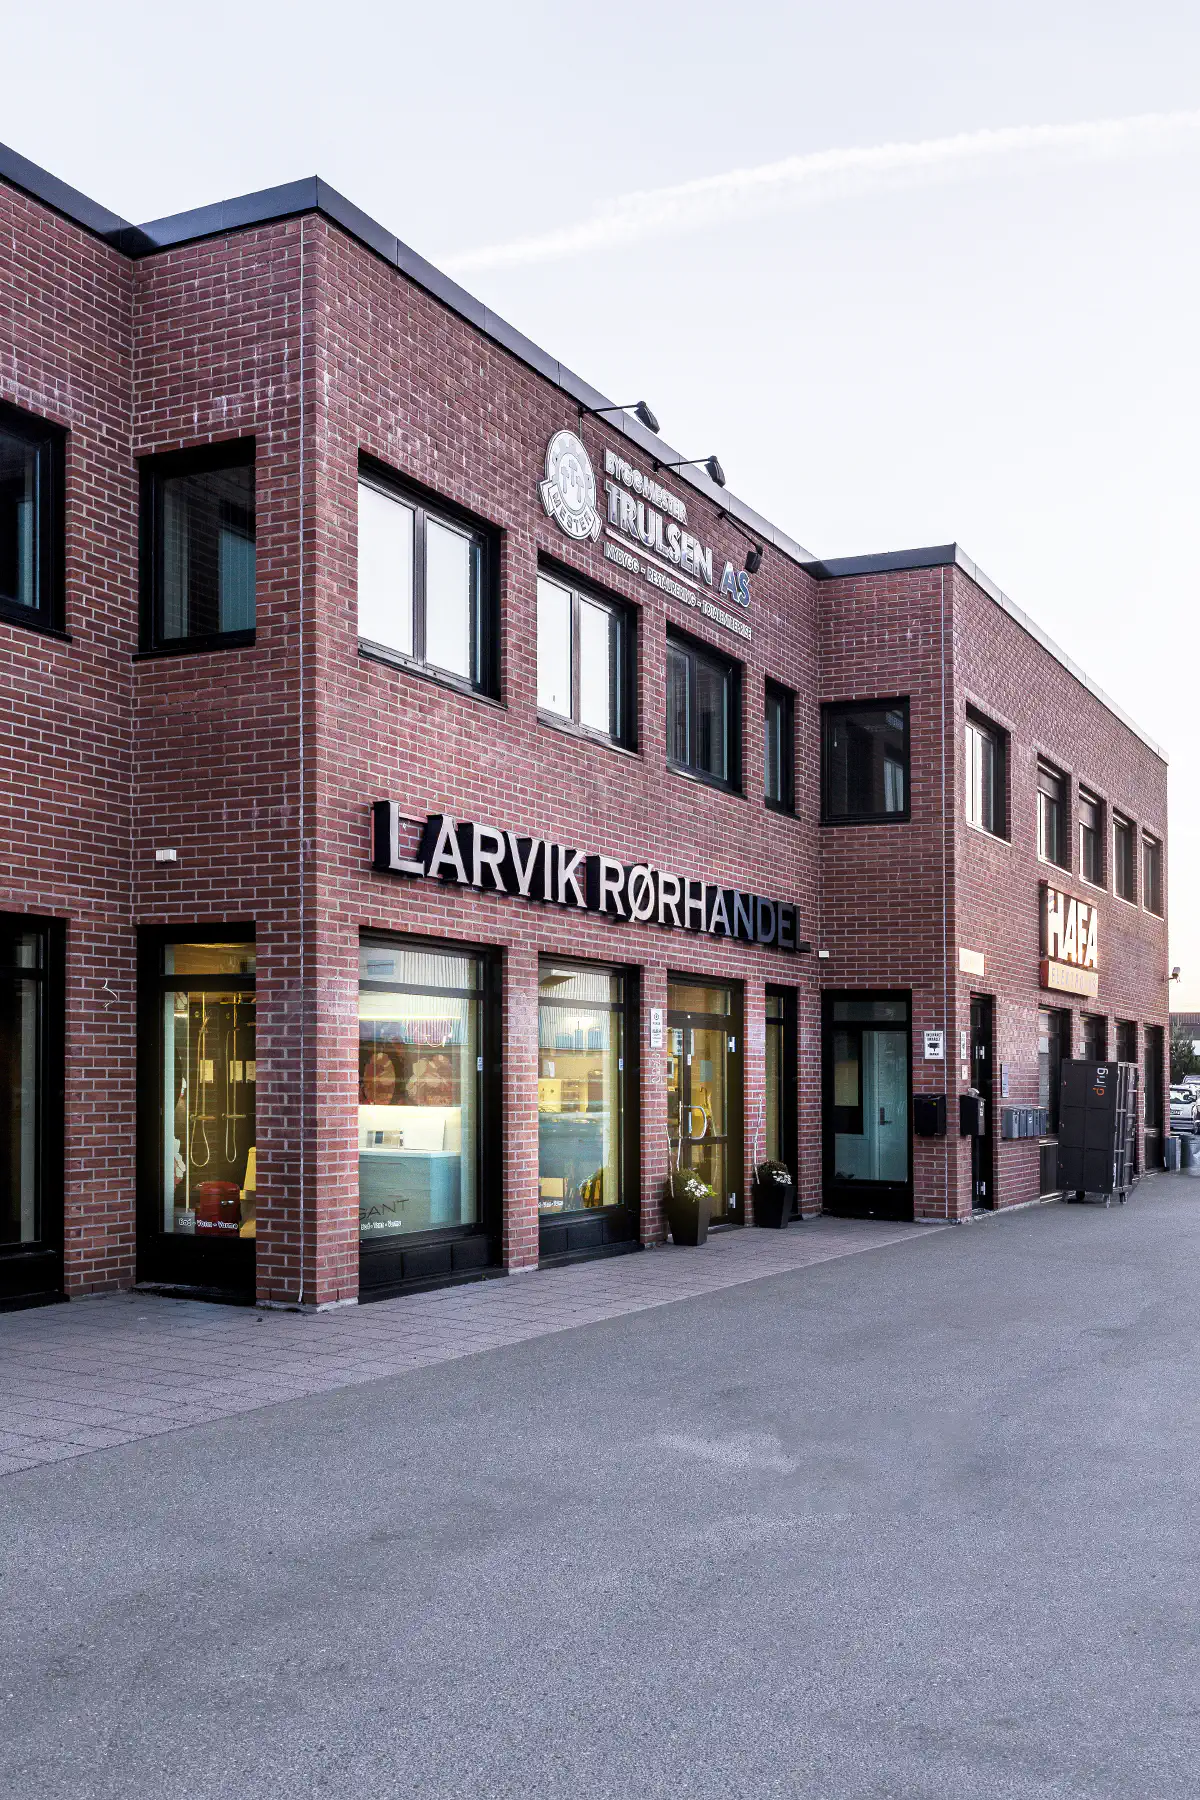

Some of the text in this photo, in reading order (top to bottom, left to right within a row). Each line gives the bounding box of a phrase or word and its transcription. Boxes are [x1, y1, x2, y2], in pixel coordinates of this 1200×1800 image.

[604, 448, 688, 526] BYGGMESTER
[603, 541, 640, 574] NYBYGG
[604, 479, 751, 608] TRULSEN AS
[376, 800, 811, 953] LARVIK RØRHANDEL
[1047, 888, 1098, 969] HAFA
